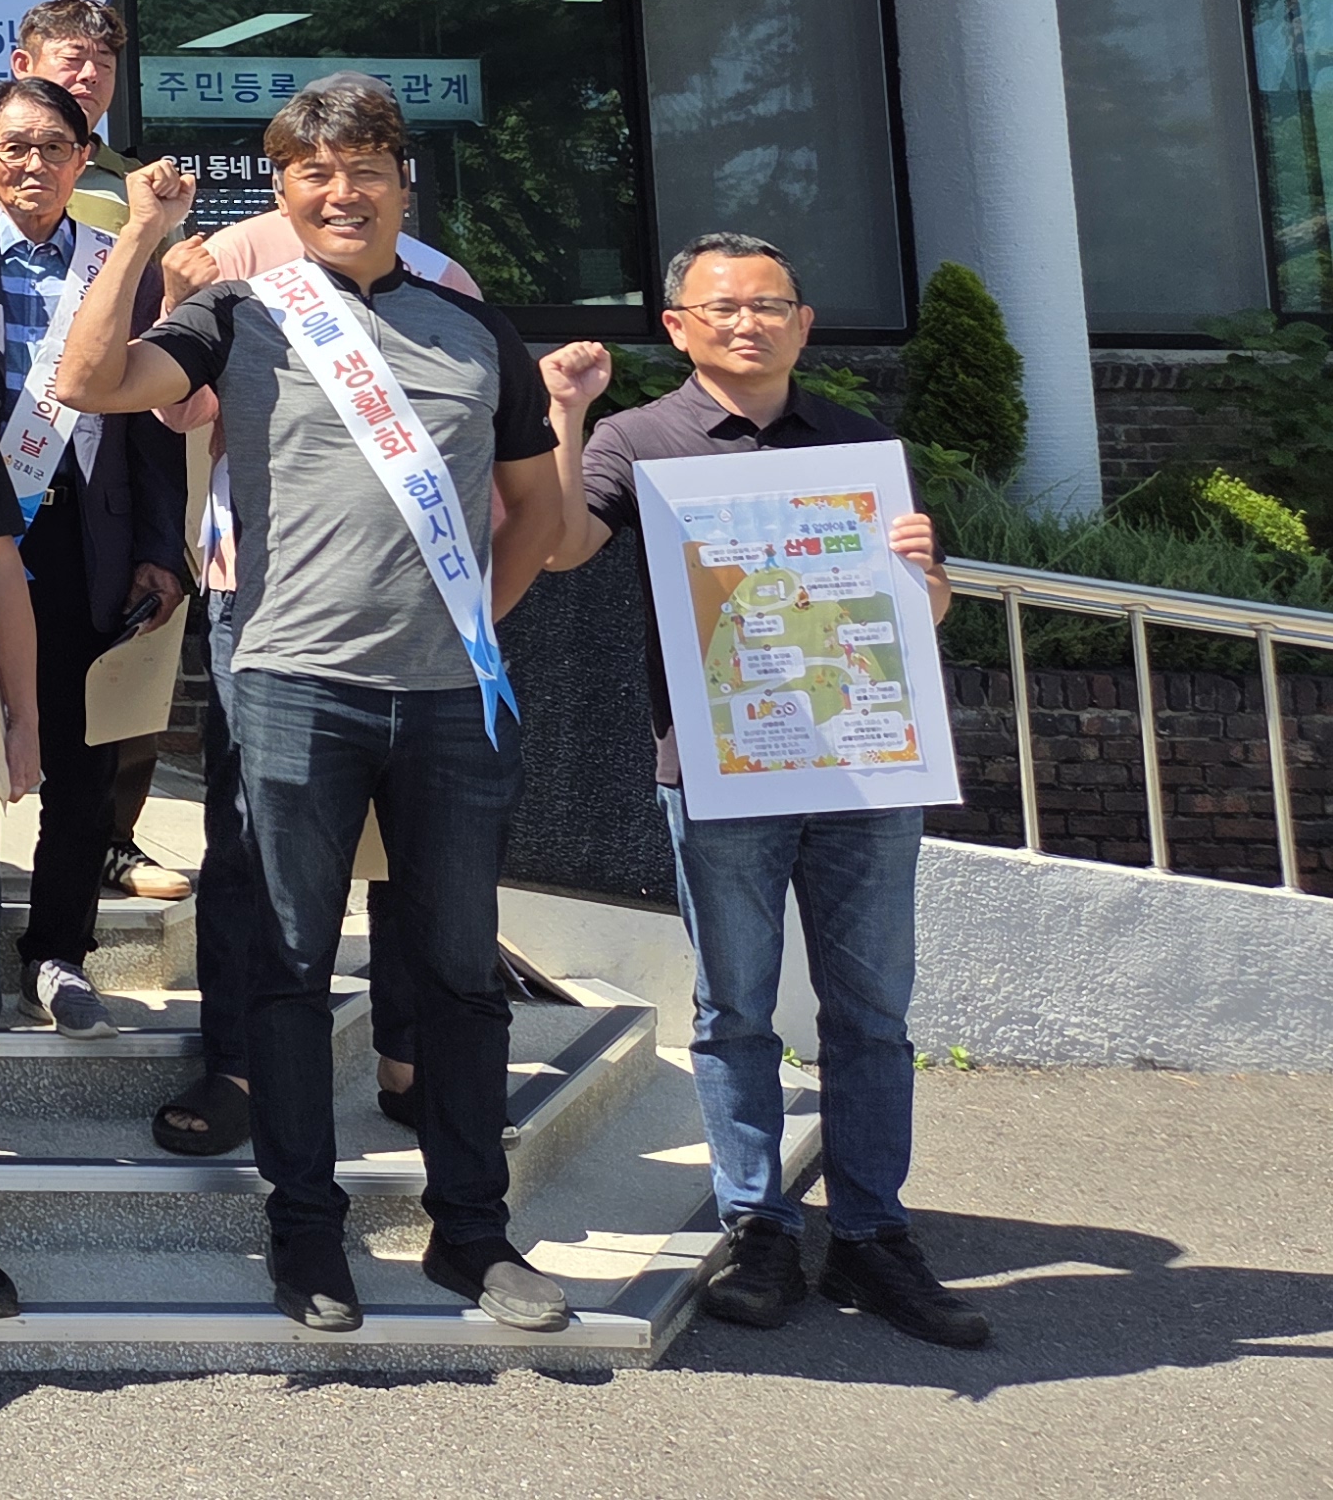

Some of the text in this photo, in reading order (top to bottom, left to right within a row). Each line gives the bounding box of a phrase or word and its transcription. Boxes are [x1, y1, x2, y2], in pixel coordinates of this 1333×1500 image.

[157, 71, 296, 103] 주민등록
[207, 155, 252, 182] 동네
[263, 265, 471, 583] 안전을 생활화 합시다
[19, 429, 50, 459] 날
